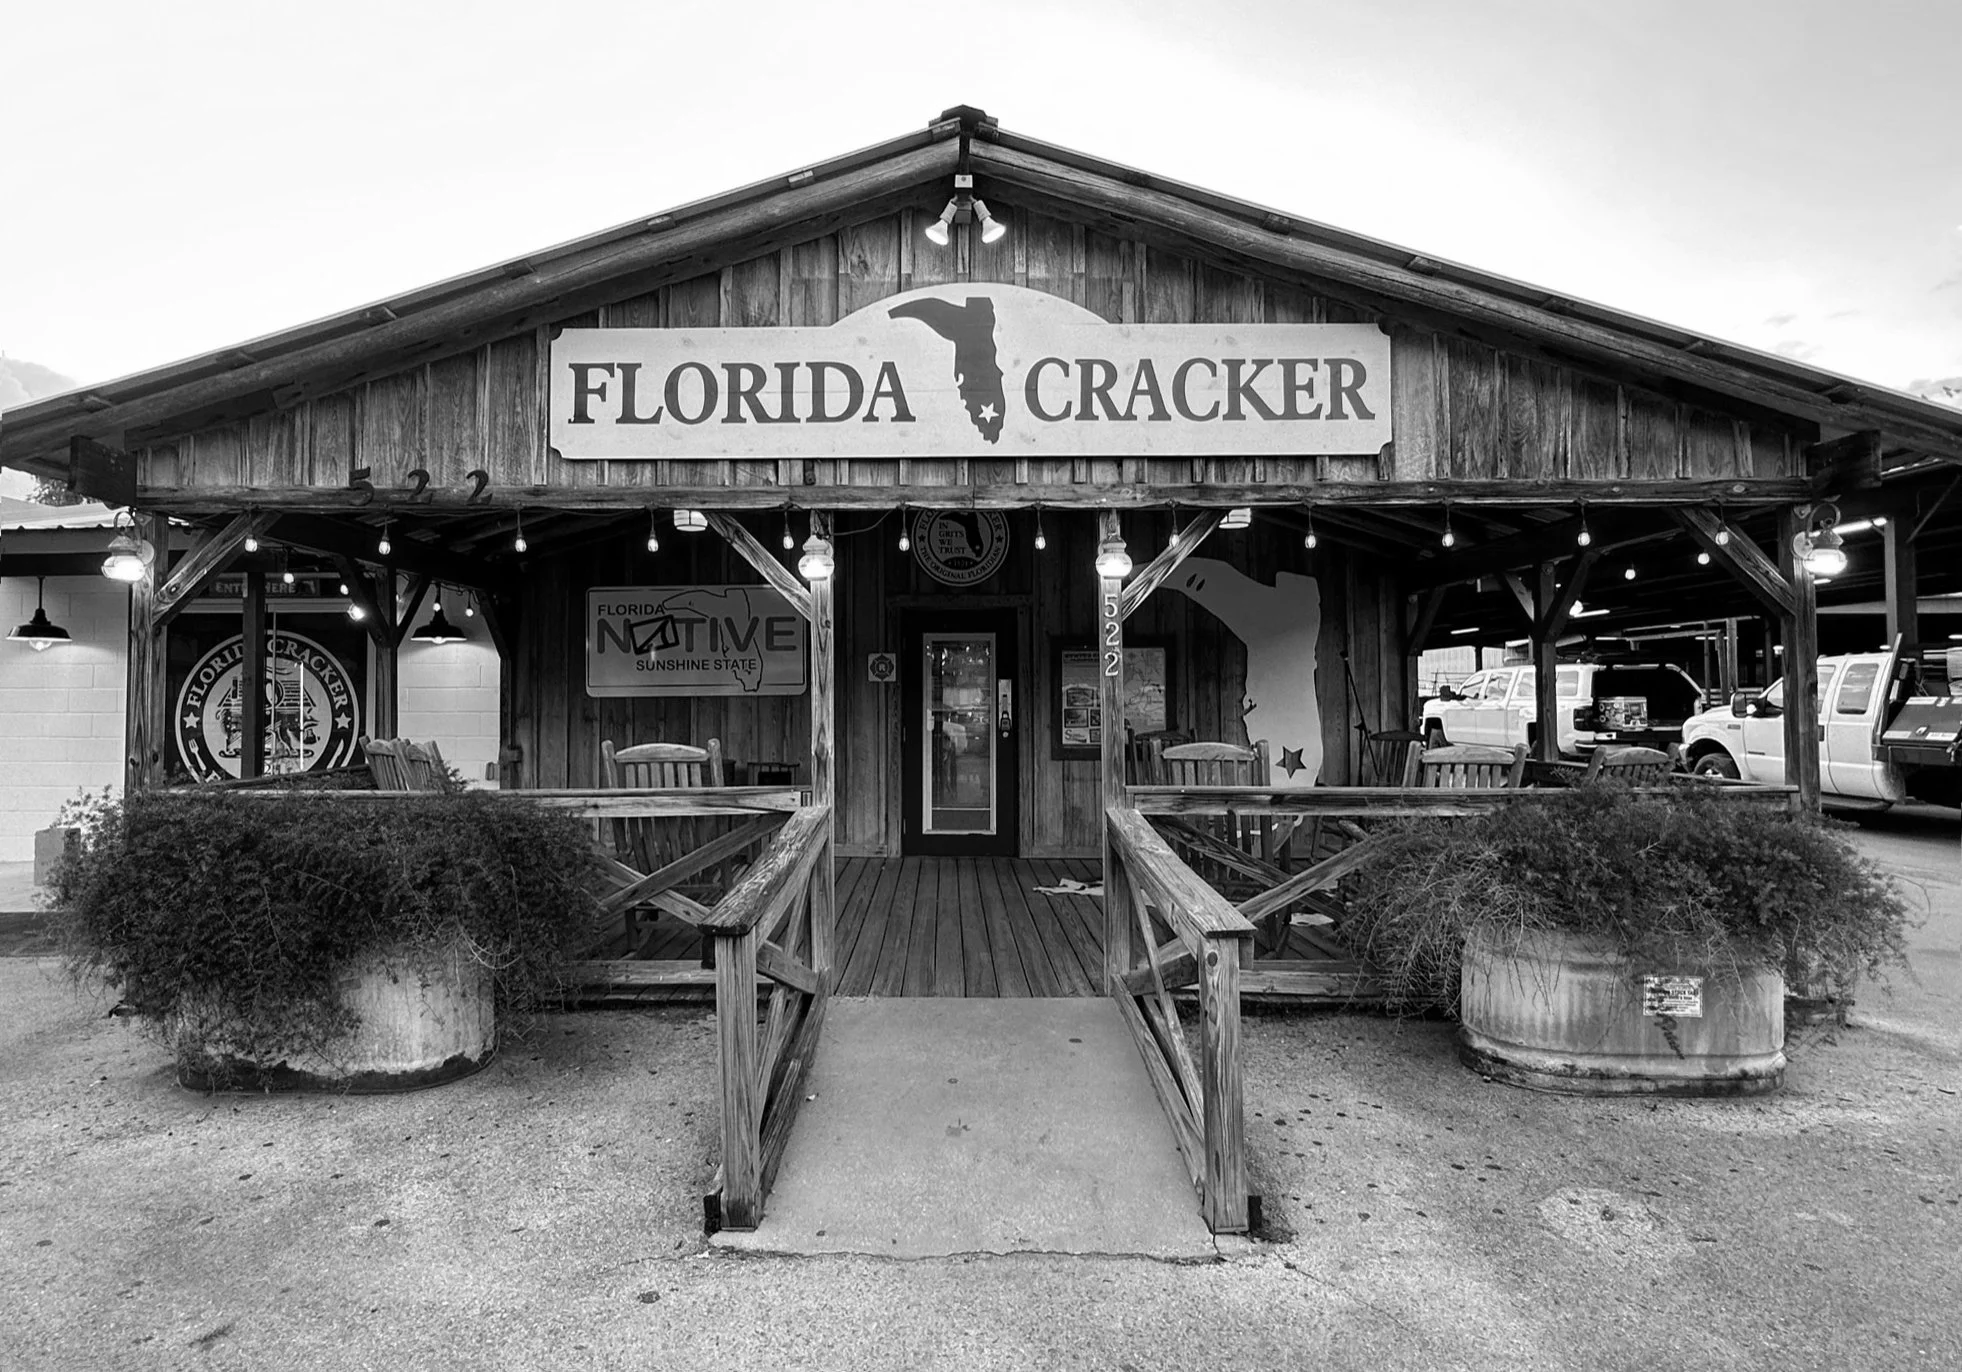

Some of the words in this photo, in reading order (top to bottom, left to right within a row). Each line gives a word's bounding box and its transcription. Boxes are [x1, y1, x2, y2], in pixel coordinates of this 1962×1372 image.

[568, 361, 917, 425] FLORIDA
[1025, 355, 1377, 421] CRACKER
[350, 466, 494, 506] 522
[930, 561, 966, 579] ORIGINAL
[598, 604, 664, 616] FLORIDA
[1104, 594, 1120, 677] 522
[187, 644, 243, 708] FLORID
[267, 639, 347, 709] CRACKER
[636, 659, 709, 671] SUNSHINE
[714, 658, 757, 670] STATE
